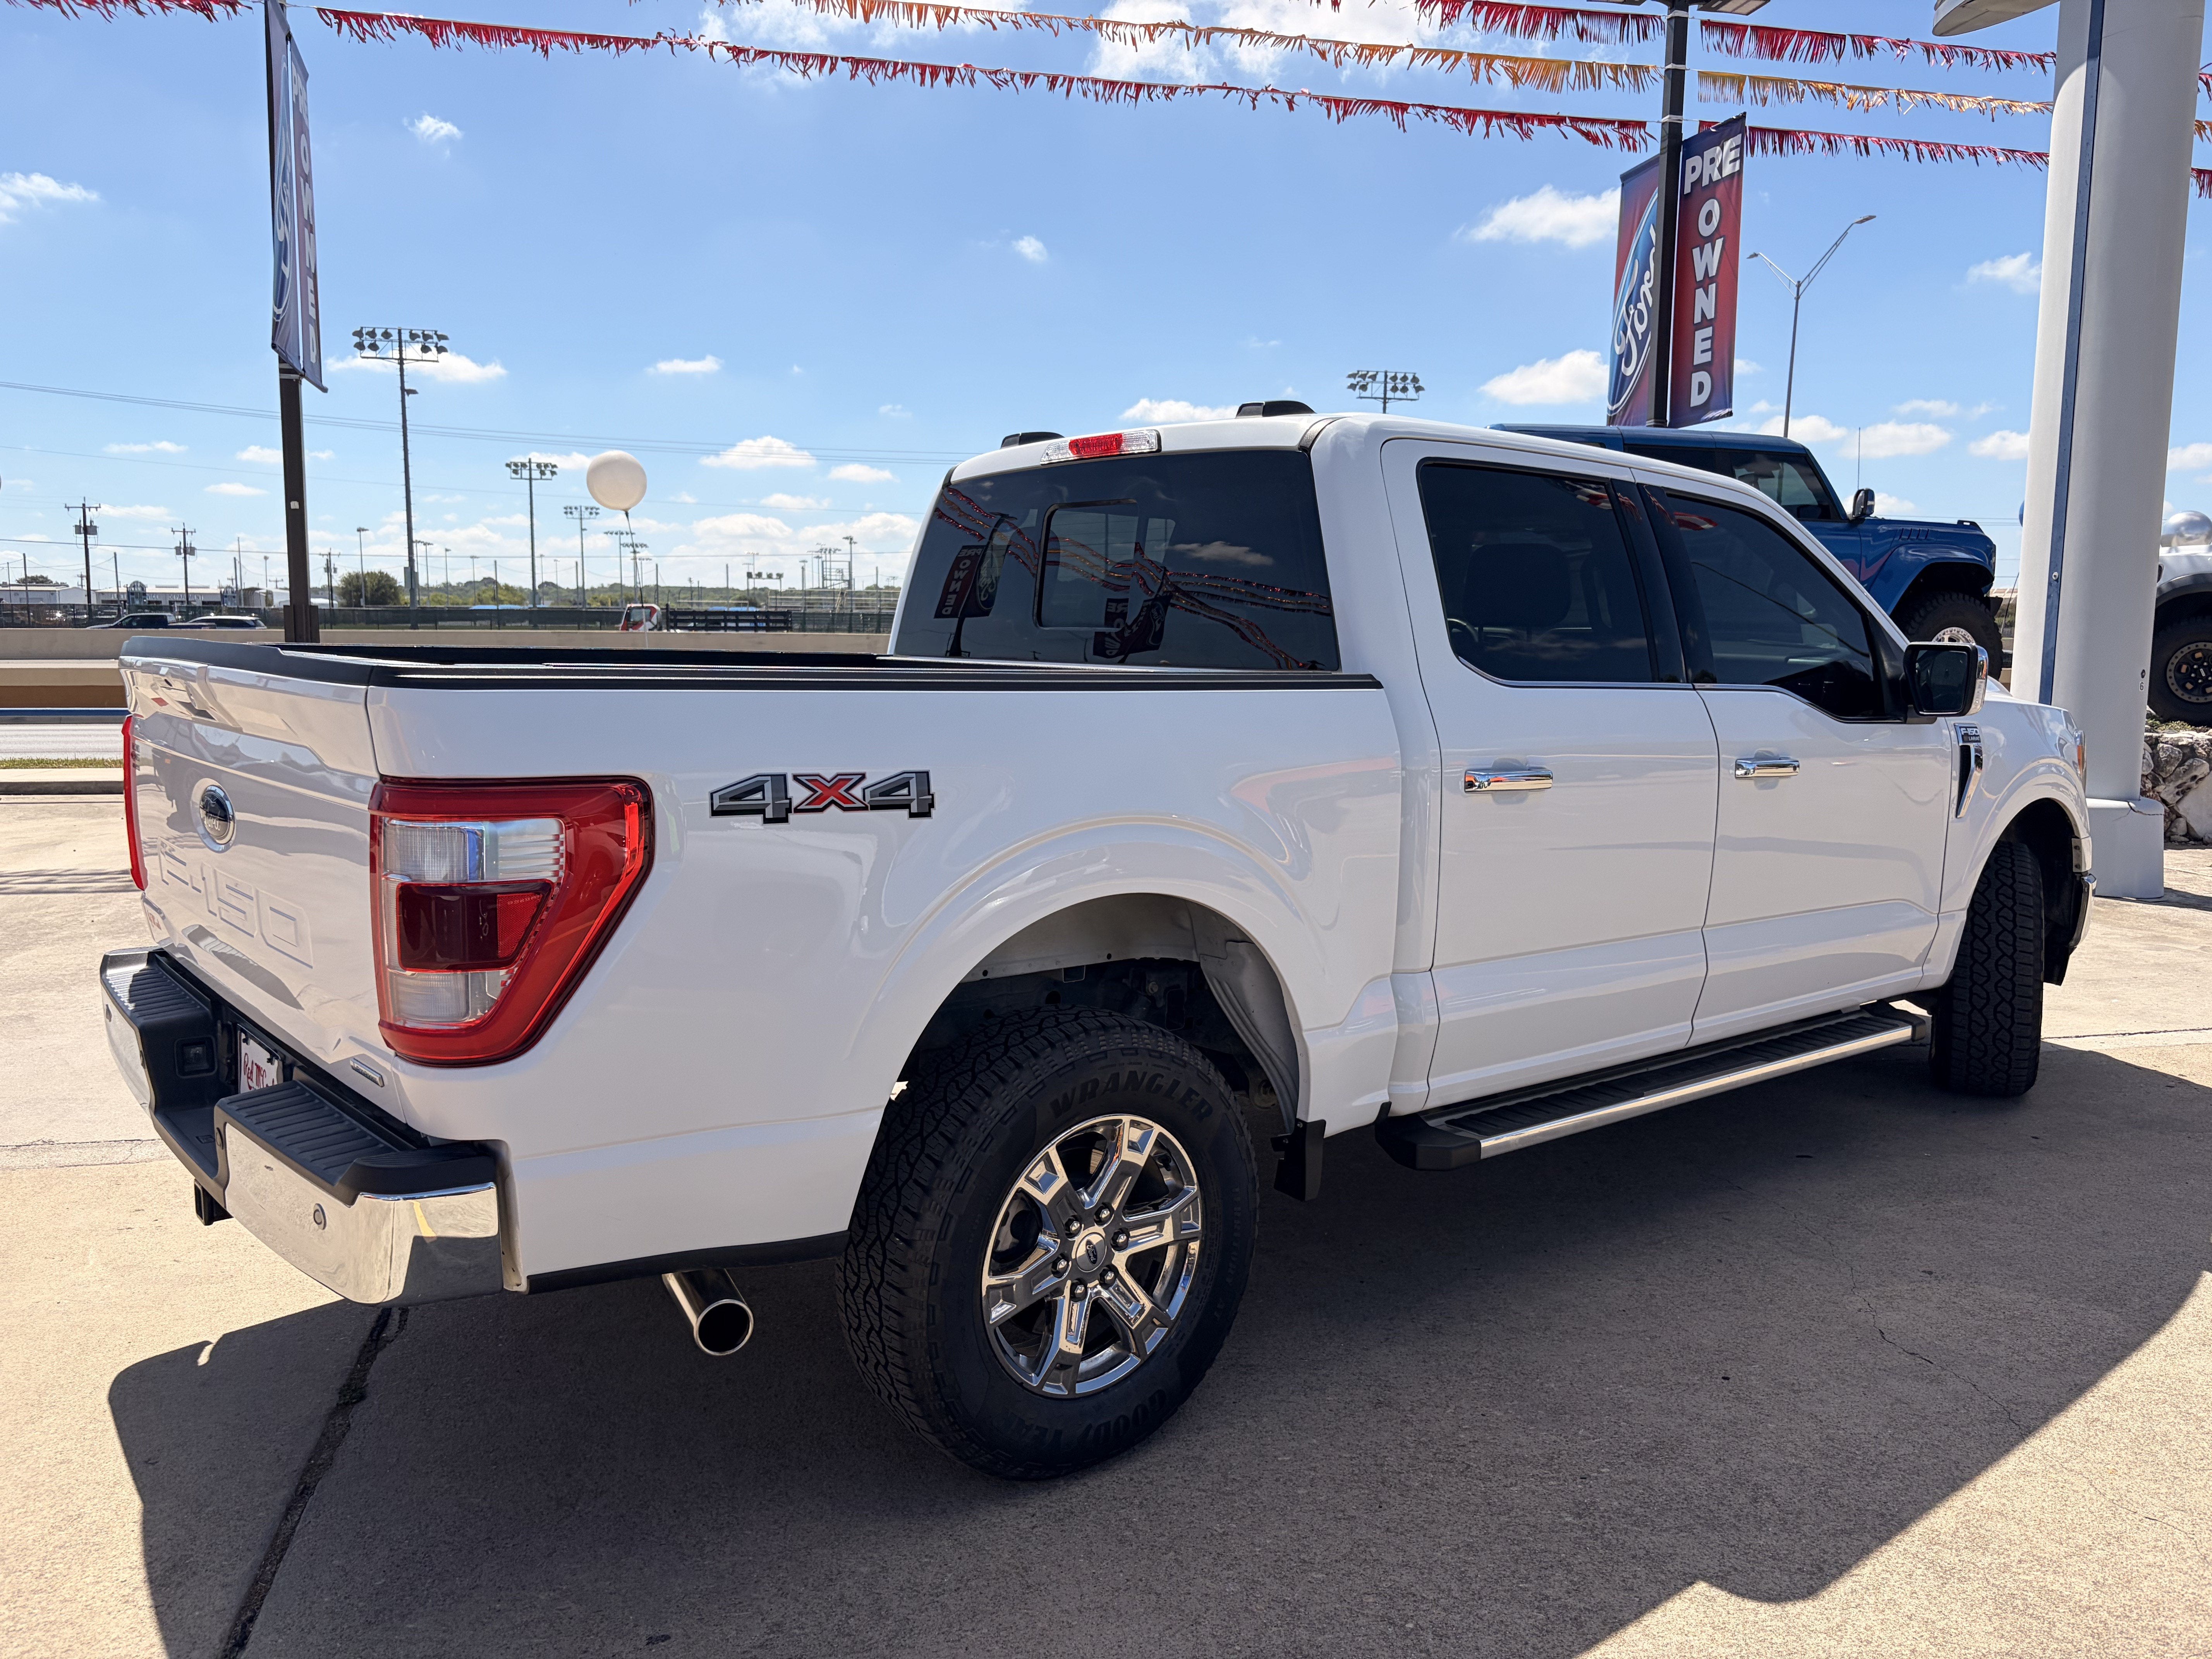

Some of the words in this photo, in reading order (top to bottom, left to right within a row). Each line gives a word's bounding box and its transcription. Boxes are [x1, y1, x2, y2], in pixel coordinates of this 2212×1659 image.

[1684, 134, 1742, 195] PRE
[300, 134, 317, 364] OWNED
[1690, 199, 1724, 408] OWNED
[2140, 682, 2144, 690] 6
[158, 836, 313, 969] F-150
[244, 1053, 254, 1091] Red
[1049, 1070, 1214, 1123] WRANGLER
[1087, 1245, 1096, 1262] Ford
